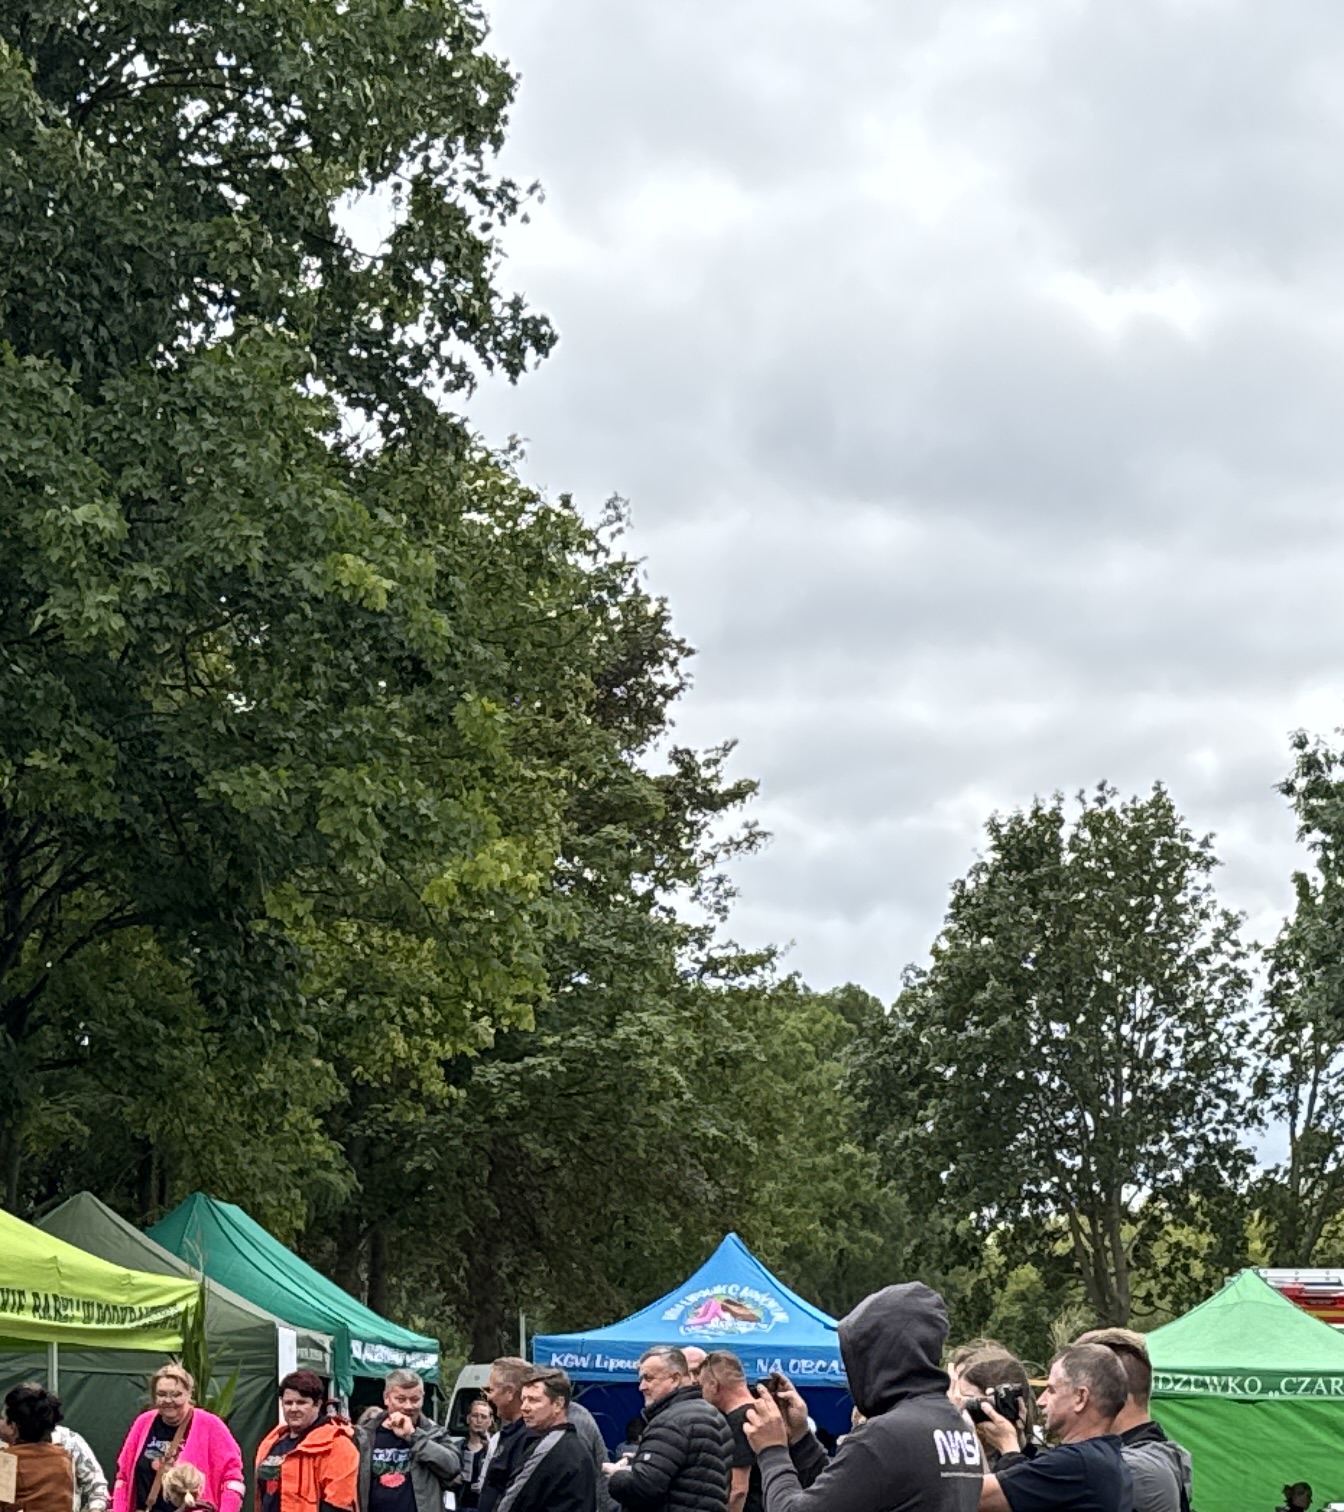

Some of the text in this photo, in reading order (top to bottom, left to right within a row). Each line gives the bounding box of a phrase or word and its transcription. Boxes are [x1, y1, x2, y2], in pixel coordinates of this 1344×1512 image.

[550, 1352, 591, 1368] KGW
[756, 1358, 783, 1374] NA
[1153, 1375, 1262, 1396] DZEWKO
